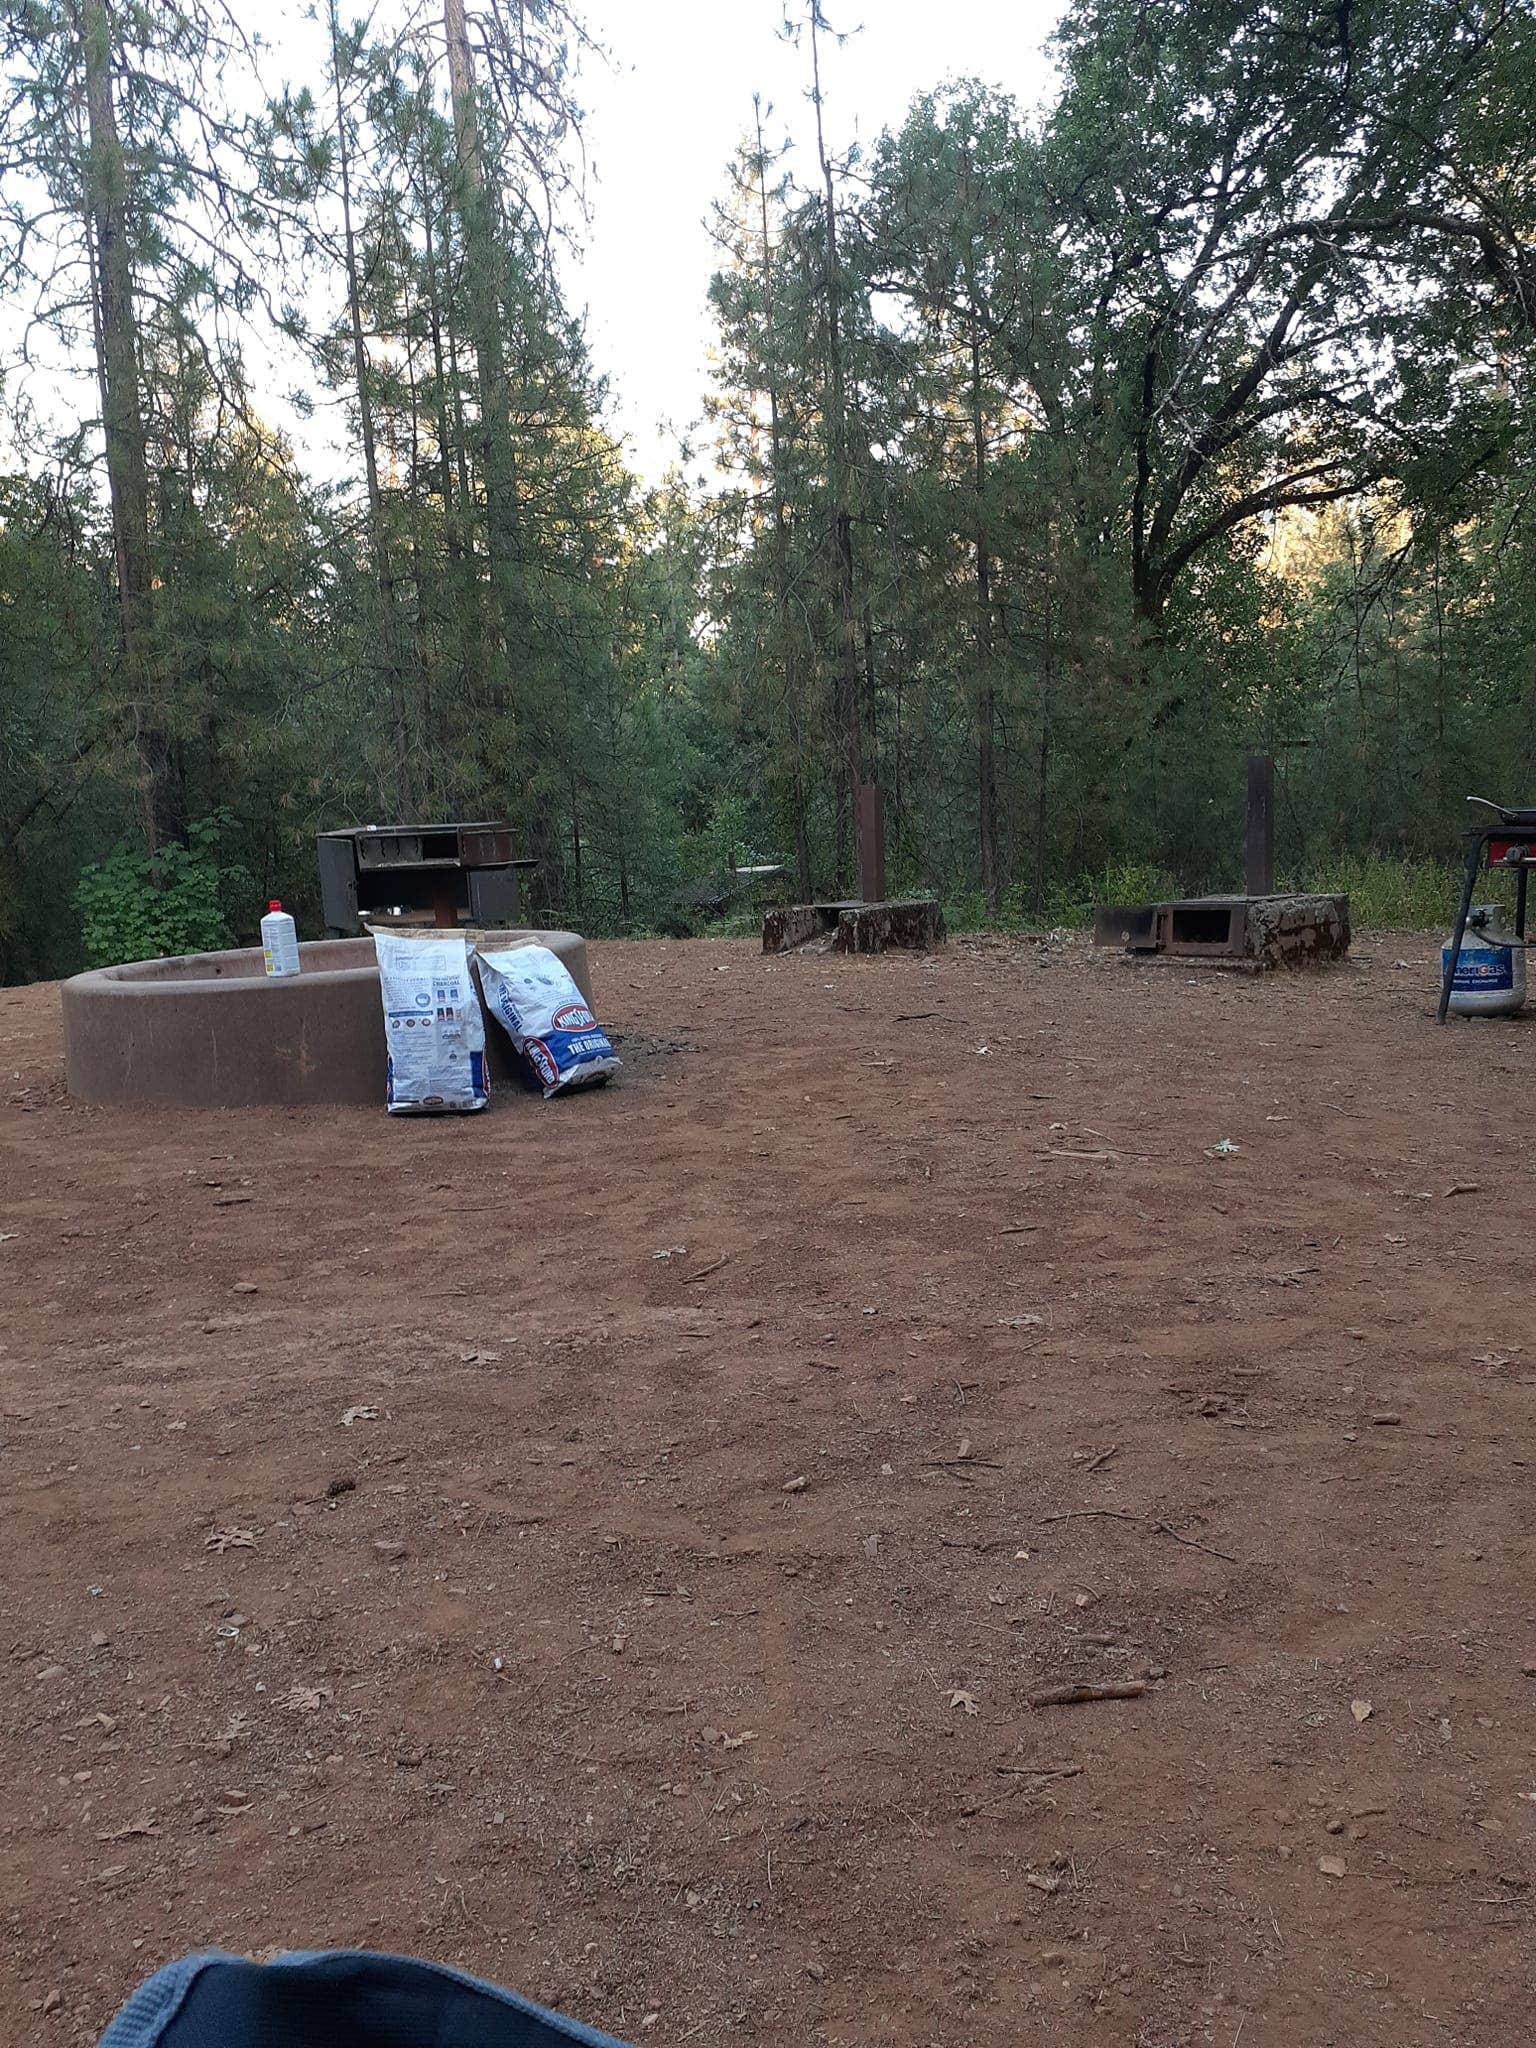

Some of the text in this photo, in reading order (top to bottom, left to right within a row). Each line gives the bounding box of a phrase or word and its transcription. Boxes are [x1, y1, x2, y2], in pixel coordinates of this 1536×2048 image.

[1454, 964, 1504, 975] meriGas
[567, 1041, 585, 1056] THE
[525, 1040, 555, 1085] KINGSFORD
